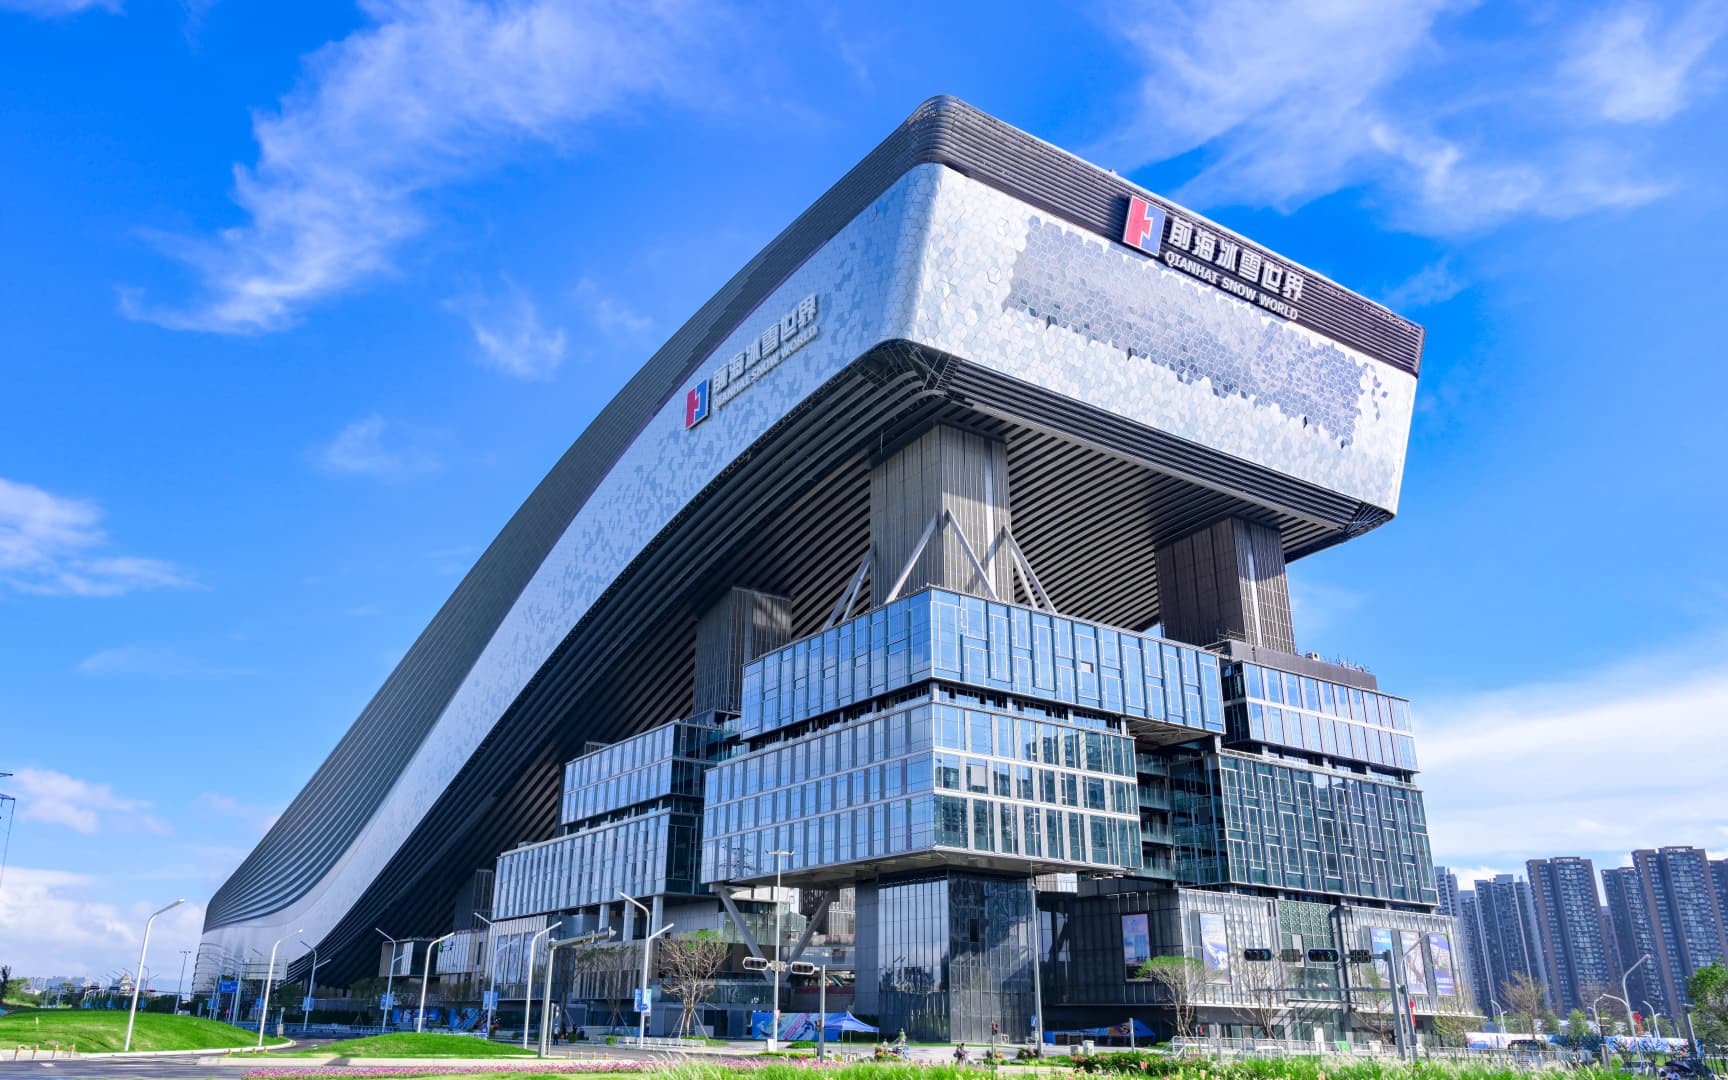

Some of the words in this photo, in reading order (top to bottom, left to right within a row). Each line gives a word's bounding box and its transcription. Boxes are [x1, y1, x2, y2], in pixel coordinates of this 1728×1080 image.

[1167, 216, 1305, 302] 前海冰雪世界
[1220, 276, 1257, 301] SNOW
[1259, 294, 1298, 320] WORLD
[712, 294, 817, 394] 前海冰雪世界
